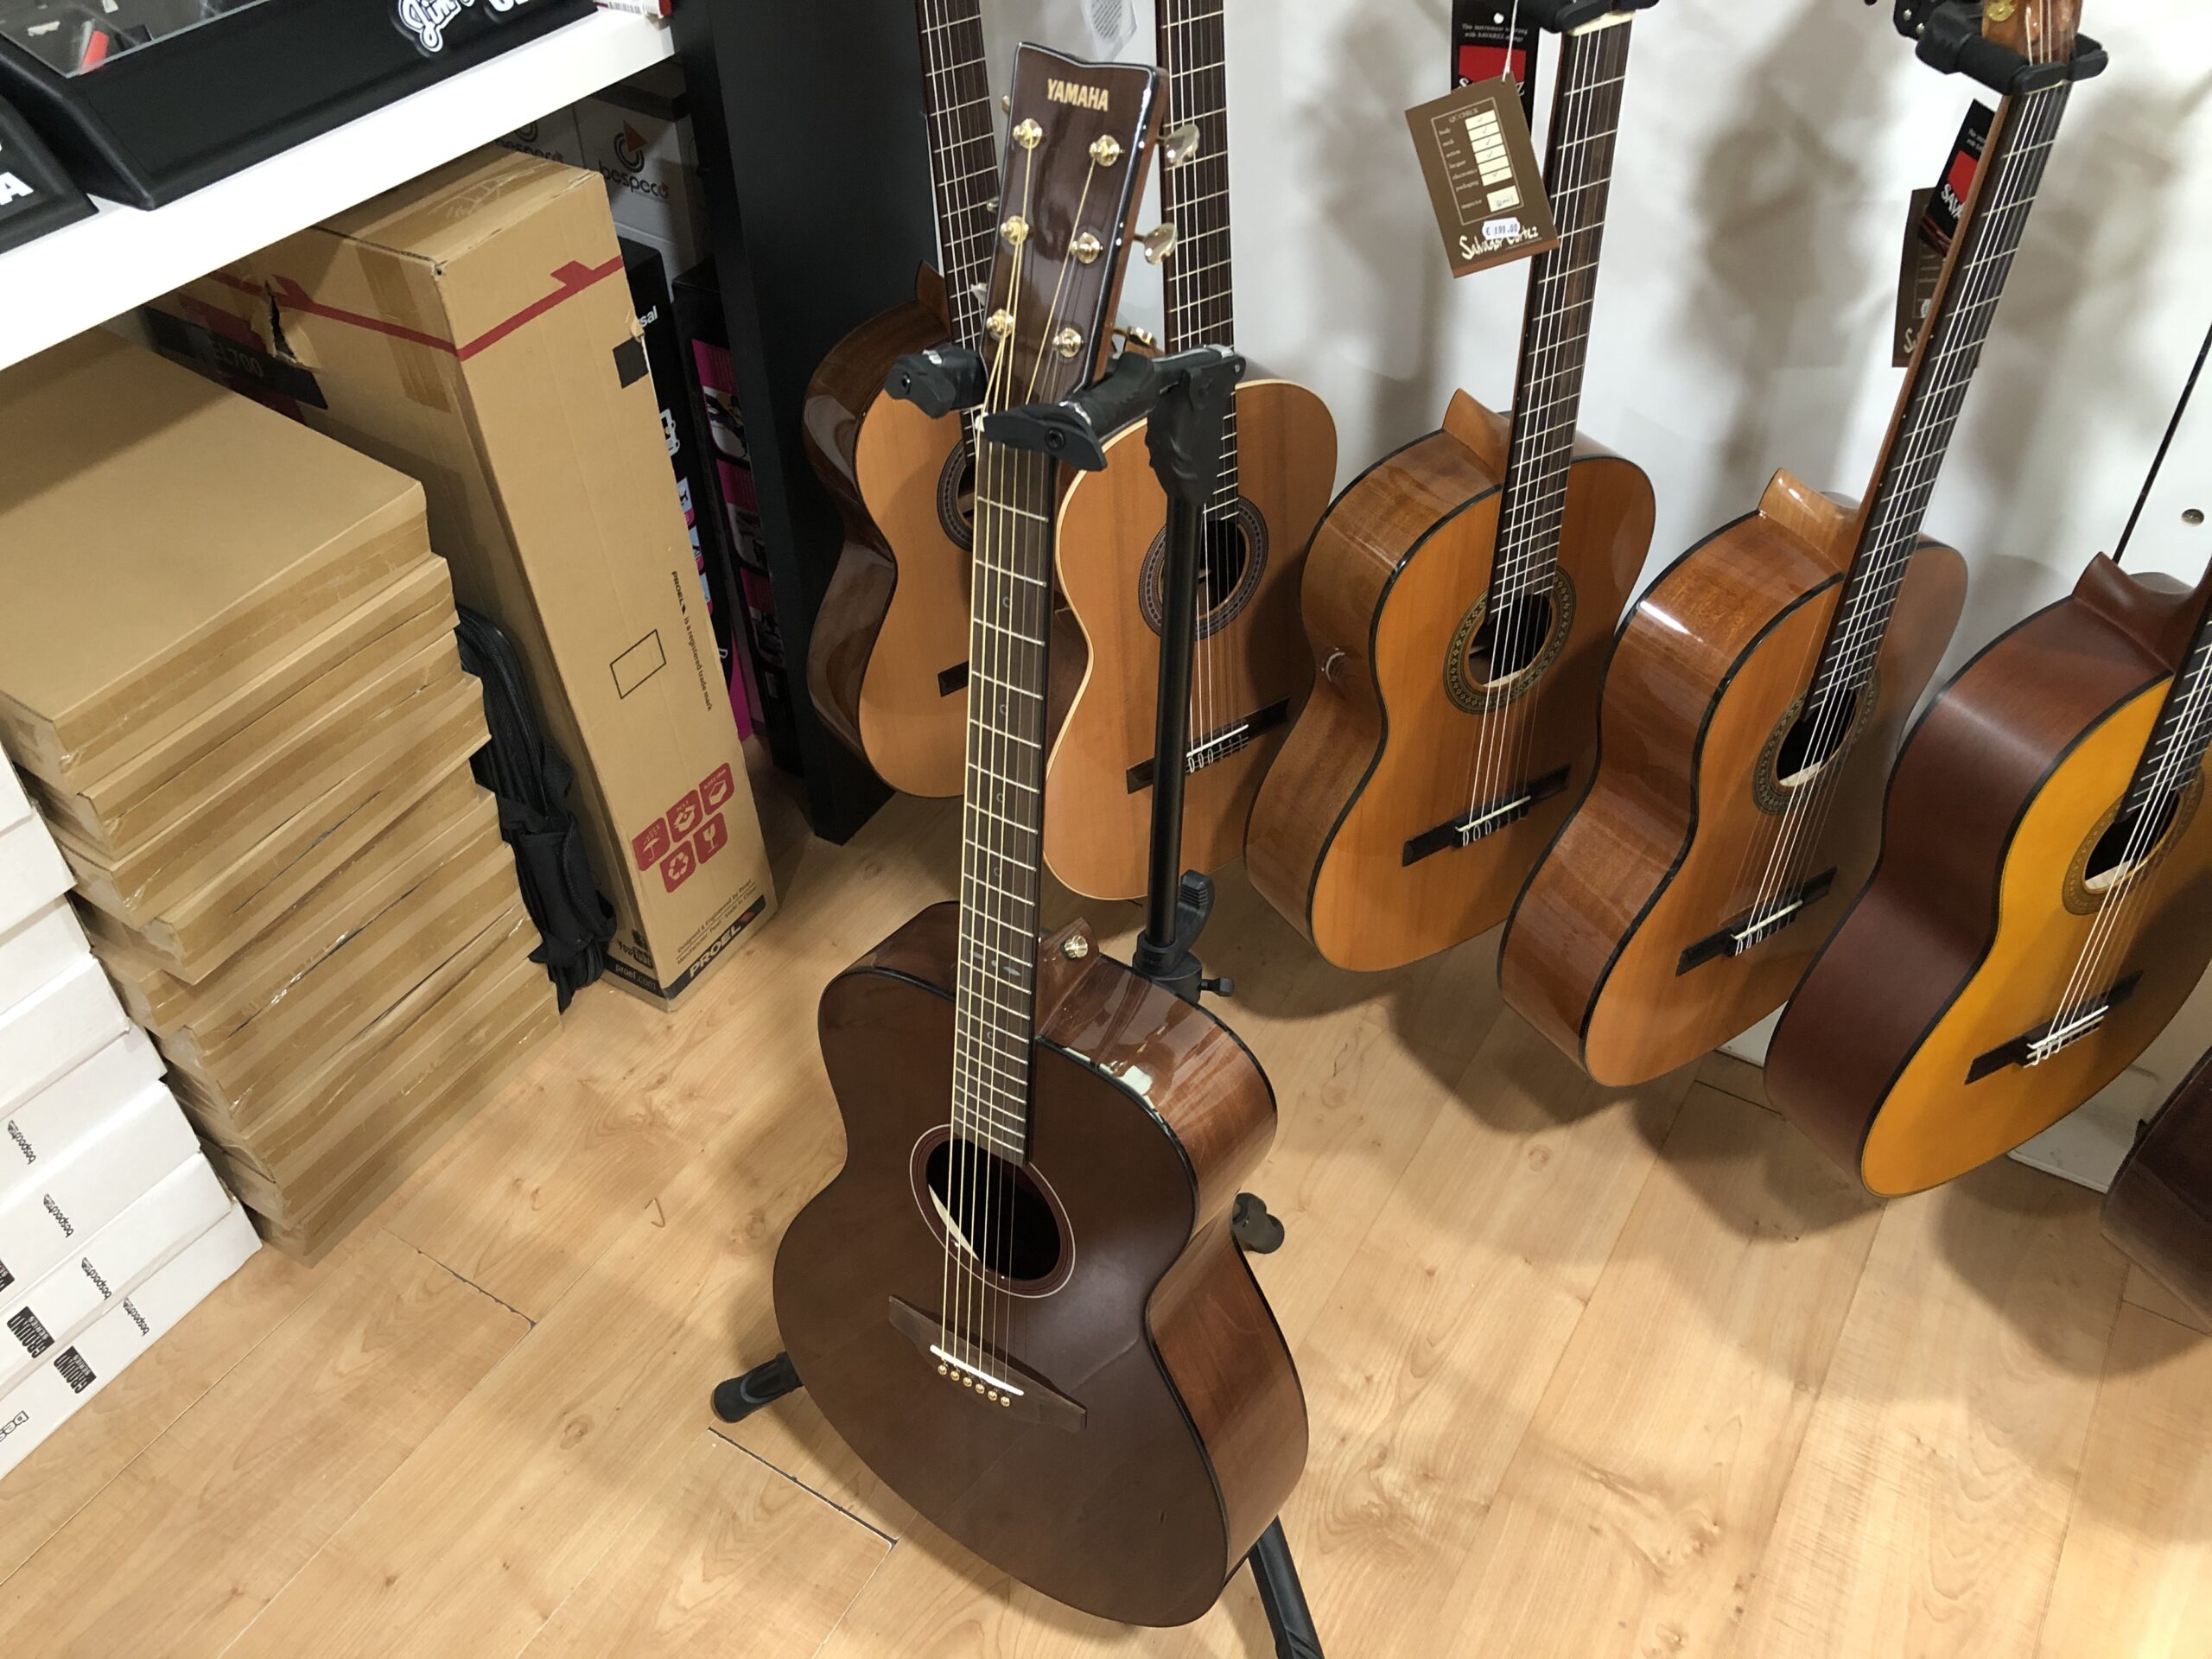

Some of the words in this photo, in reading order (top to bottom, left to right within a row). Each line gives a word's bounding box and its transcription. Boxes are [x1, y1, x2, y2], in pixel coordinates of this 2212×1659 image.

[1047, 78, 1109, 111] YAMAHA
[599, 160, 670, 199] bespeco
[1941, 183, 1965, 218] SAVA
[671, 570, 683, 606] PROEL
[688, 631, 702, 671] registered
[697, 670, 707, 691] trade
[704, 690, 713, 711] mark
[690, 925, 741, 977] PROEL
[615, 963, 656, 991] proel.com
[7, 1314, 48, 1359] GROUND
[28, 1315, 49, 1339] SERIES
[54, 1354, 89, 1394] GROUND
